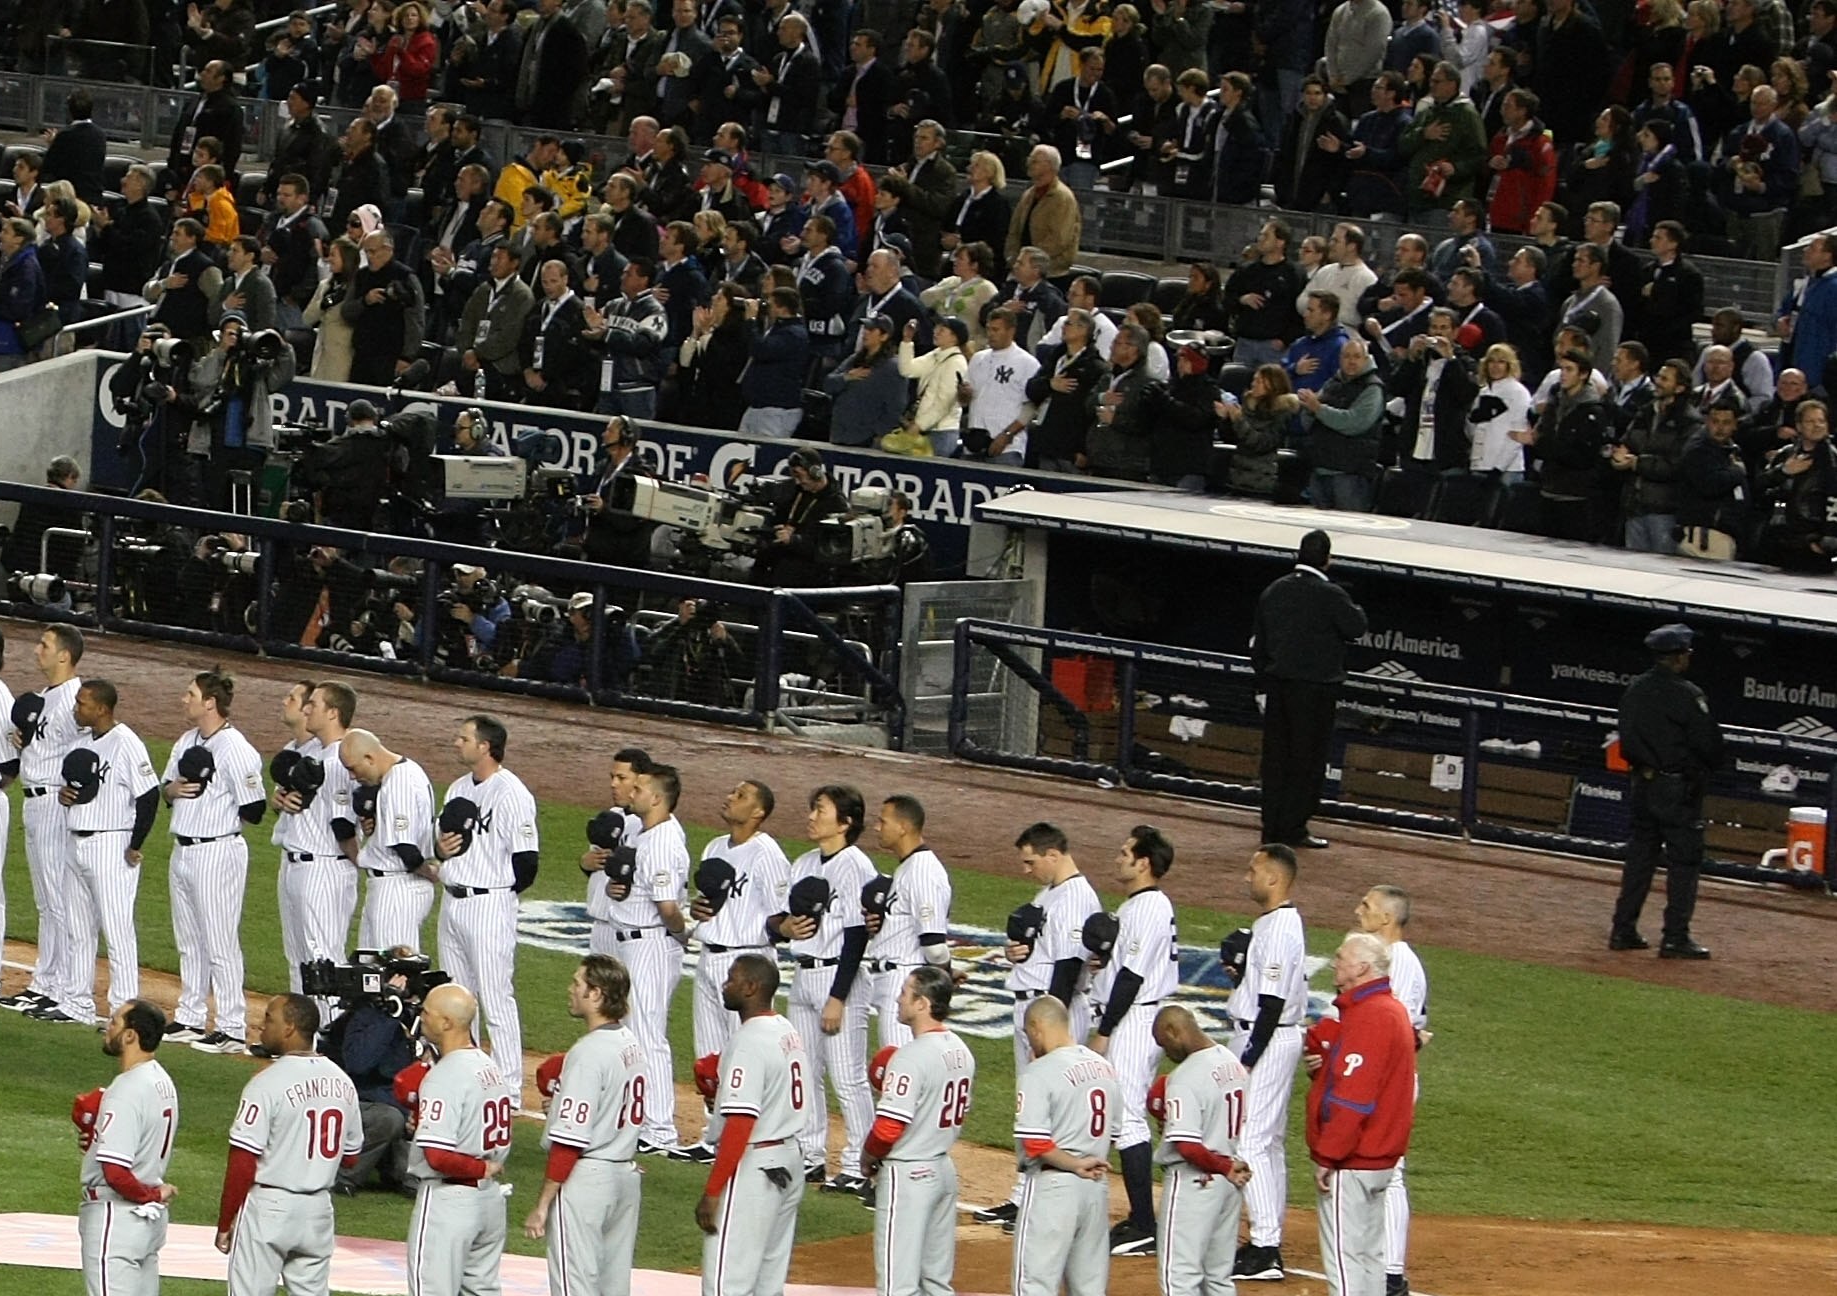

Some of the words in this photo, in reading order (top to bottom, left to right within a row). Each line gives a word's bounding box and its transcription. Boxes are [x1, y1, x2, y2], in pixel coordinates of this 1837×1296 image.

[1374, 630, 1393, 650] of
[1392, 631, 1461, 659] America
[1744, 676, 1788, 702] Bank
[1788, 684, 1807, 705] of
[1790, 840, 1814, 872] G
[286, 1076, 356, 1109] FRANCISCO
[617, 1074, 646, 1130] 28
[730, 1067, 744, 1090] 6
[790, 1060, 804, 1111] 6
[938, 1077, 971, 1130] 26
[305, 1108, 344, 1161] 10
[481, 1096, 512, 1151] 29
[559, 1097, 591, 1125] 28
[1089, 1087, 1107, 1138] 8
[1224, 1088, 1244, 1140] 11
